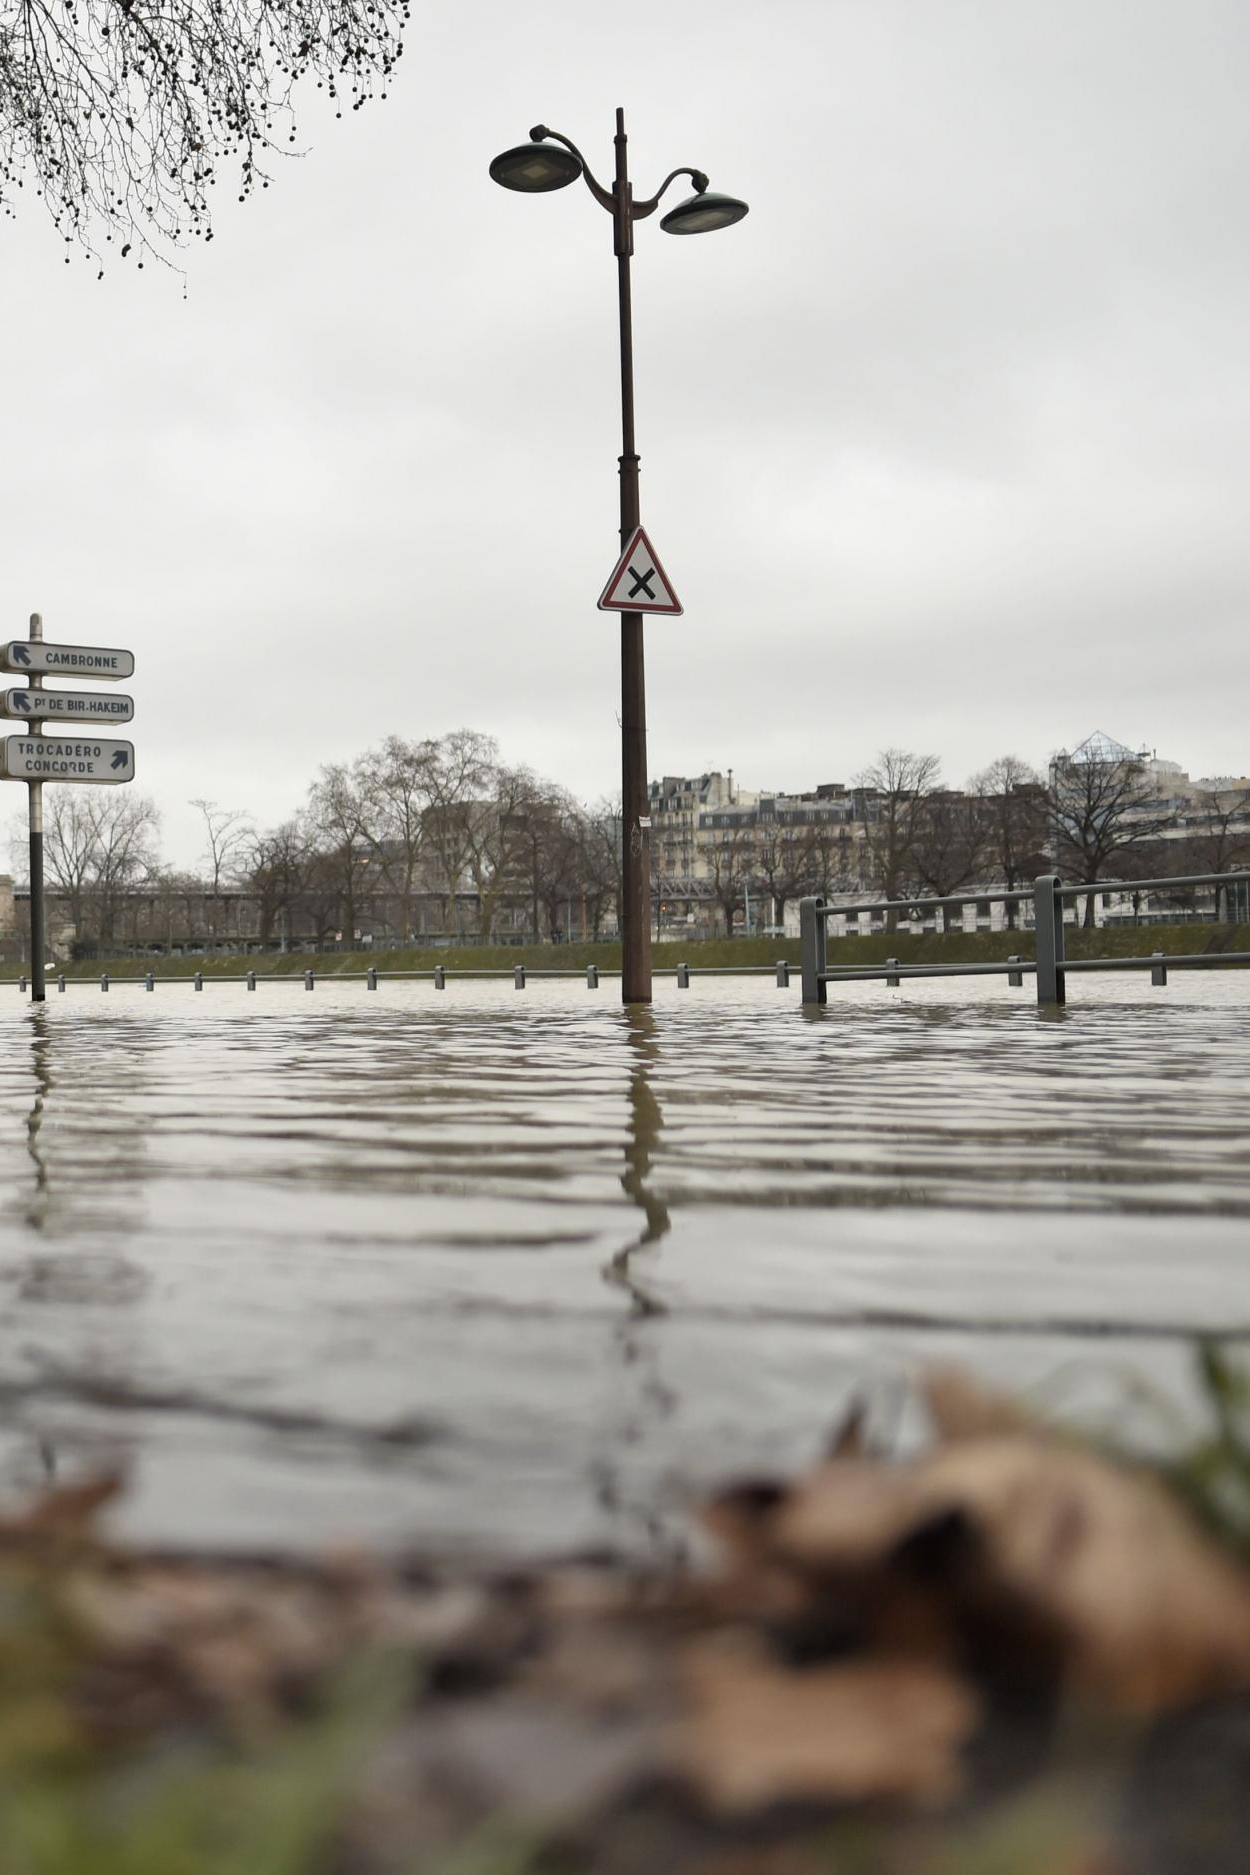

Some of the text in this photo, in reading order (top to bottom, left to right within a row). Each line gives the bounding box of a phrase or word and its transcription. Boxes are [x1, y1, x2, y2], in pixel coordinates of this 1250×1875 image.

[45, 652, 118, 669] CAMBRONNE
[49, 699, 63, 710] DE
[18, 743, 101, 757] TROCADÉRO
[25, 760, 94, 773] CONCORDE
